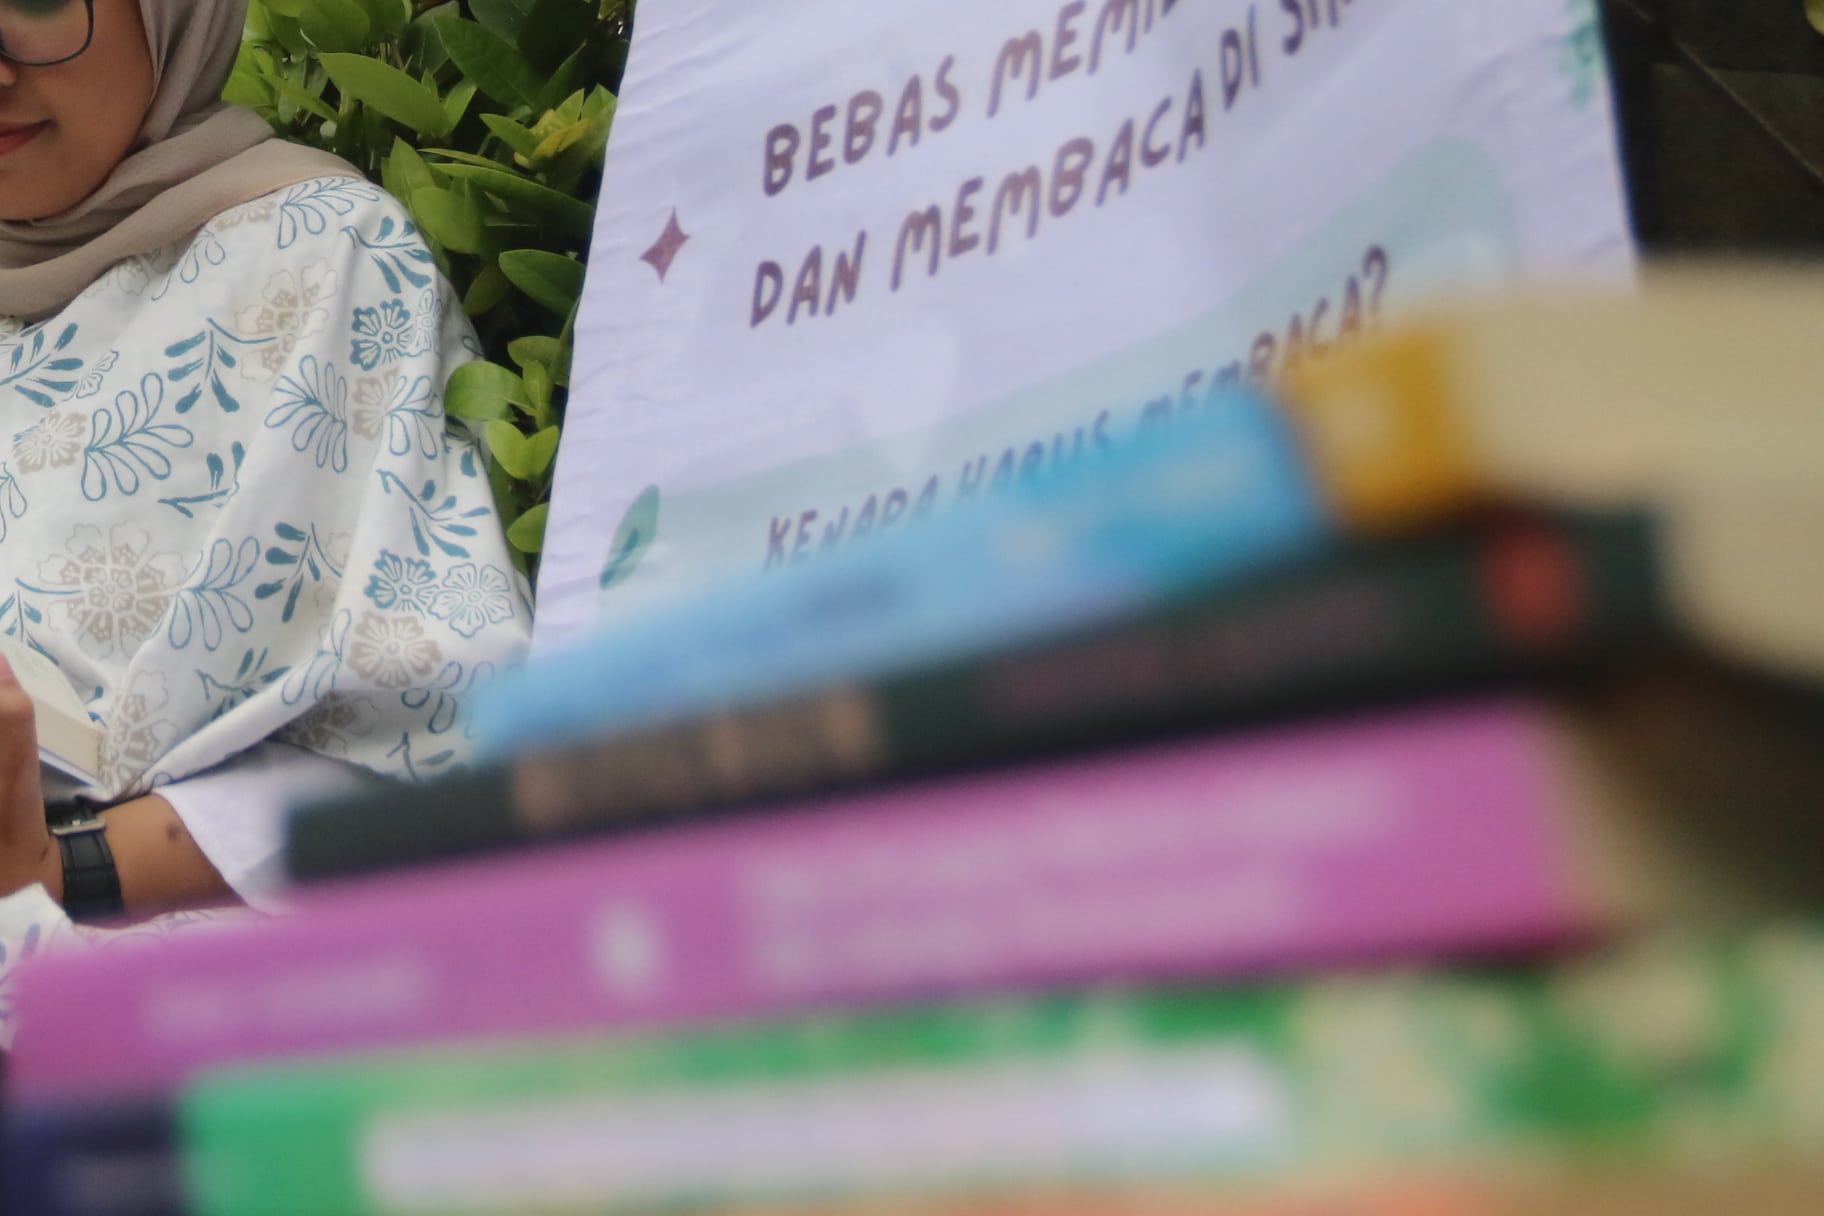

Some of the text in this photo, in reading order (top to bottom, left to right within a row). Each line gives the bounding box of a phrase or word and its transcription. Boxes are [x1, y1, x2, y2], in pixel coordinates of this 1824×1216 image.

[750, 230, 867, 328] DAN
[890, 68, 1205, 291] MEMBACA
[1220, 3, 1260, 112] DI
[763, 55, 960, 197] BEBAS
